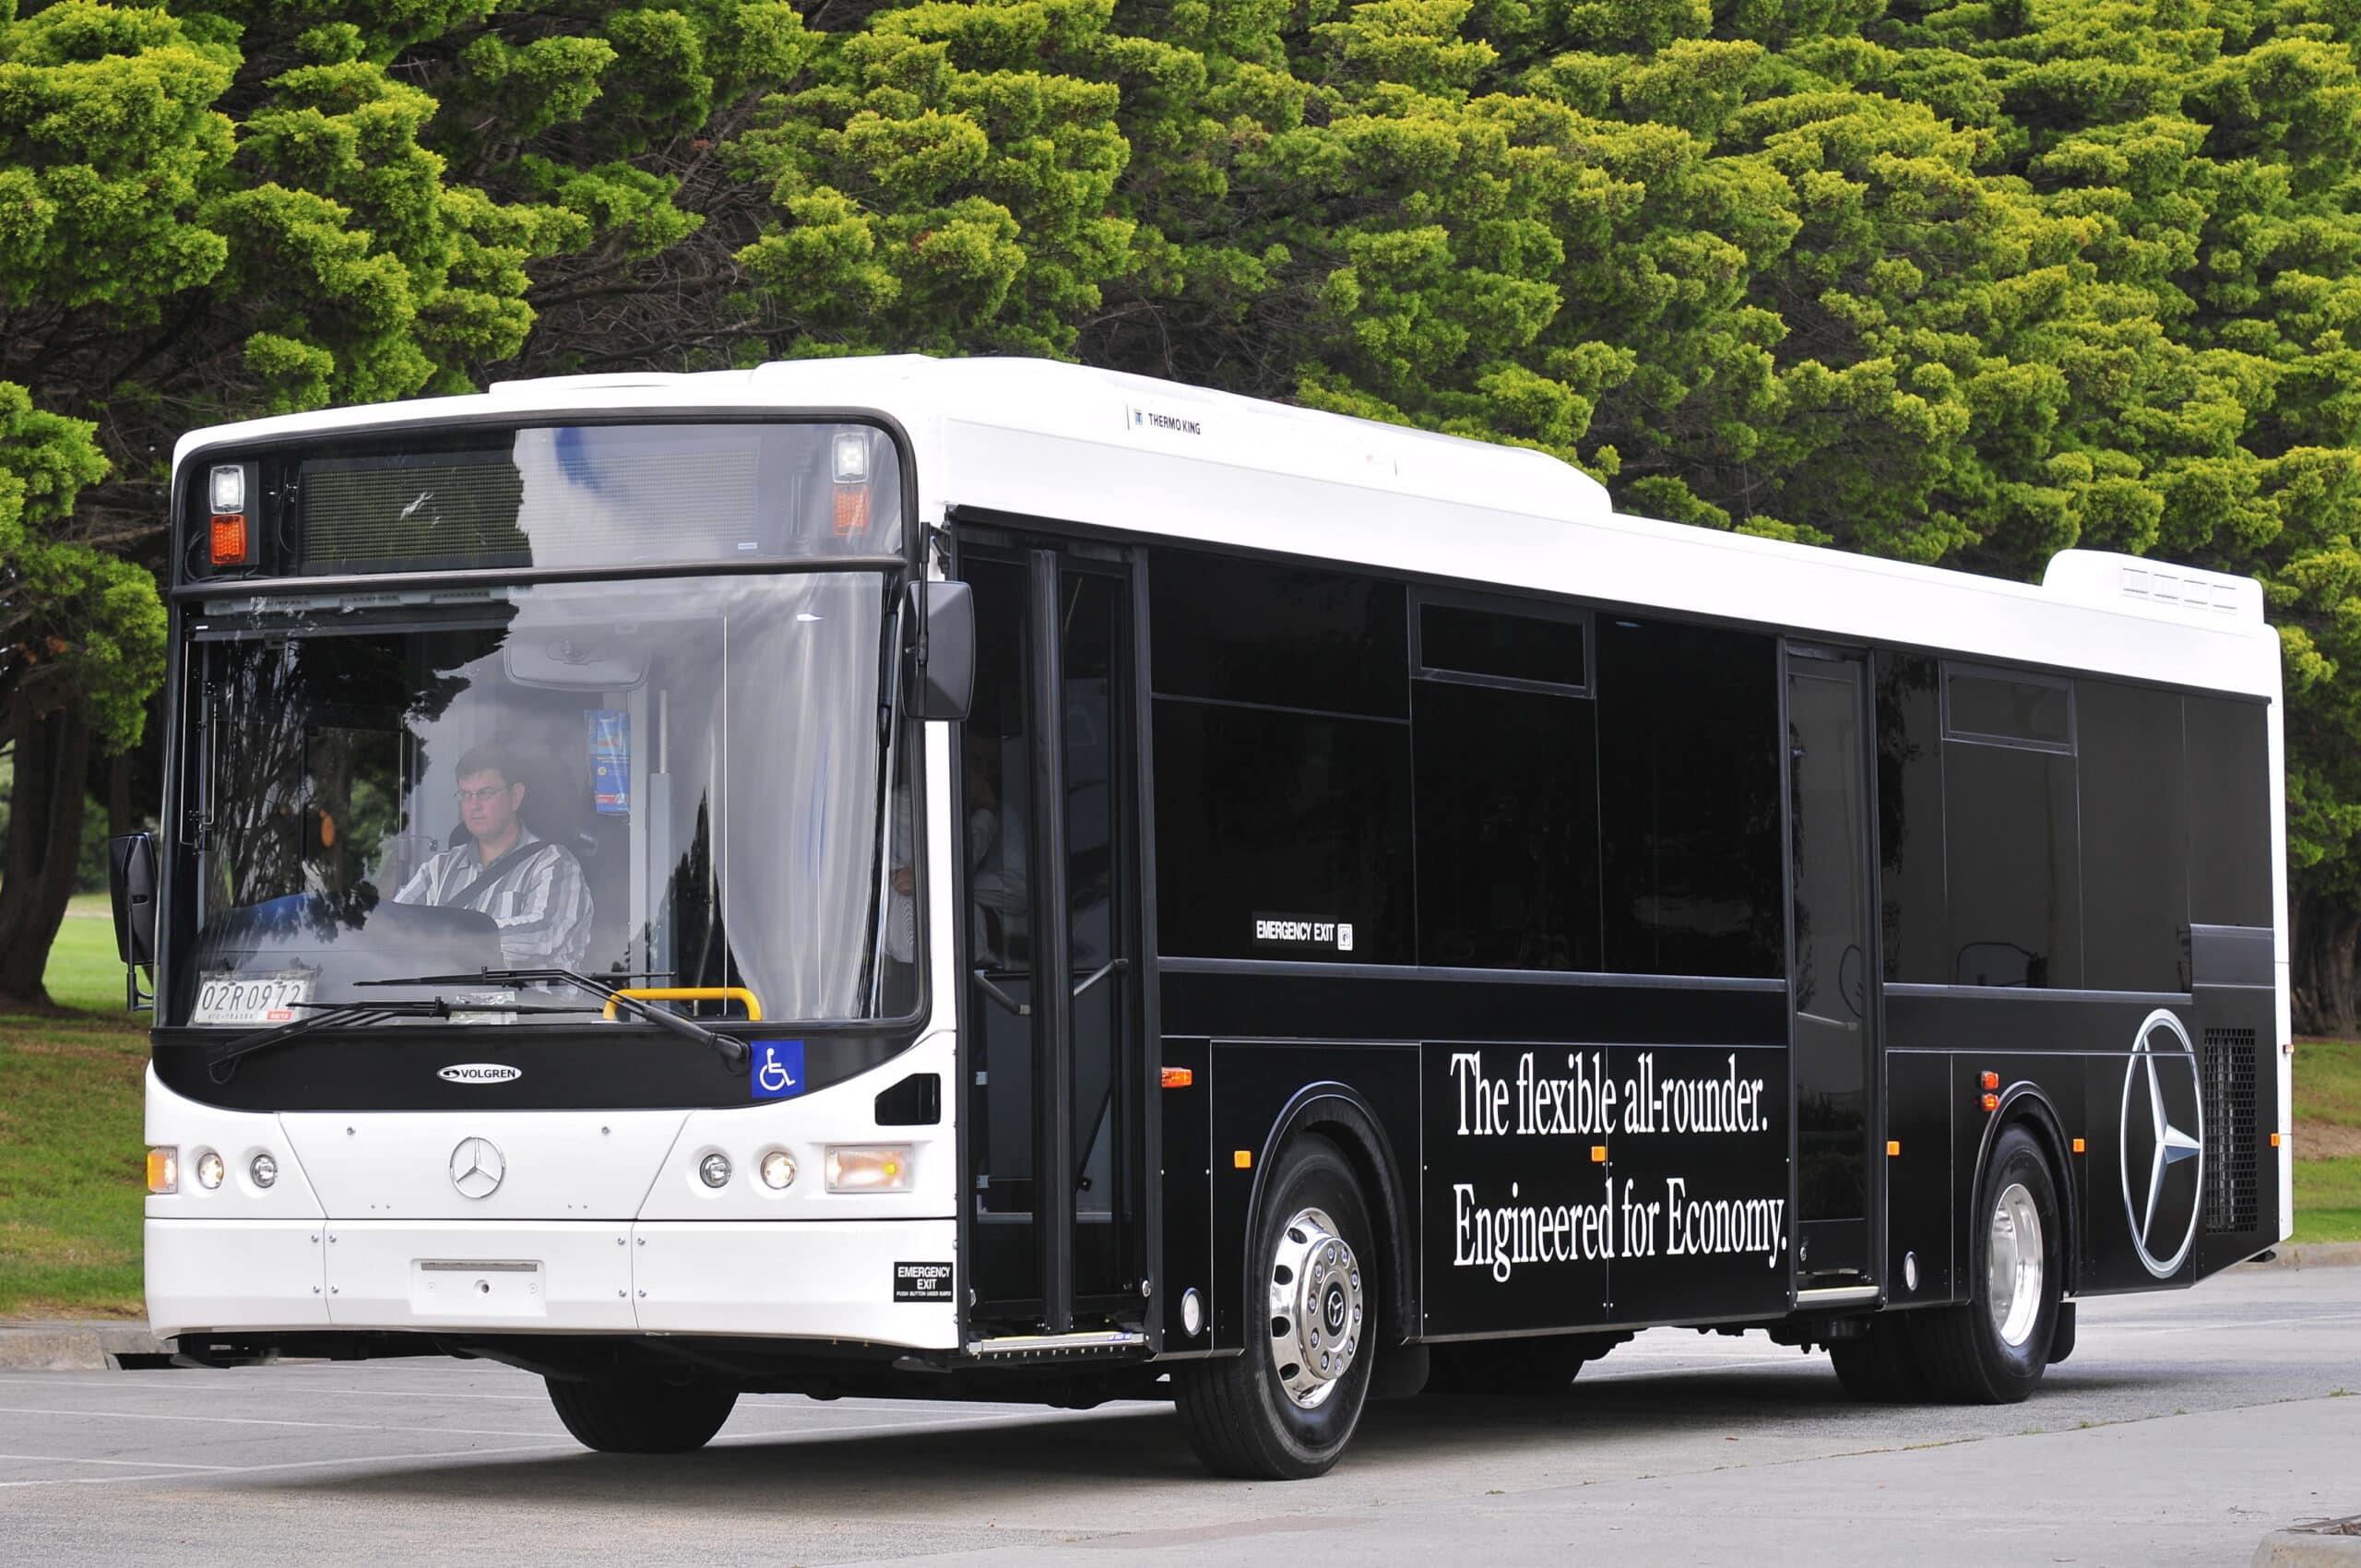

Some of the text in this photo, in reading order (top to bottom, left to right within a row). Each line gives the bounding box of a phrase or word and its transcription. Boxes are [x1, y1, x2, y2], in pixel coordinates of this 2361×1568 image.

[1148, 412, 1201, 435] THERMO KING
[1256, 920, 1335, 942] EMERGENCY EXIT
[460, 1069, 516, 1078] VOLGREN
[1450, 1051, 1768, 1135] The flexible all-rounder.
[1453, 1176, 1787, 1283] Engineered for Economy.
[897, 1266, 951, 1278] EMERGENCY
[917, 1278, 937, 1290] EXIT
